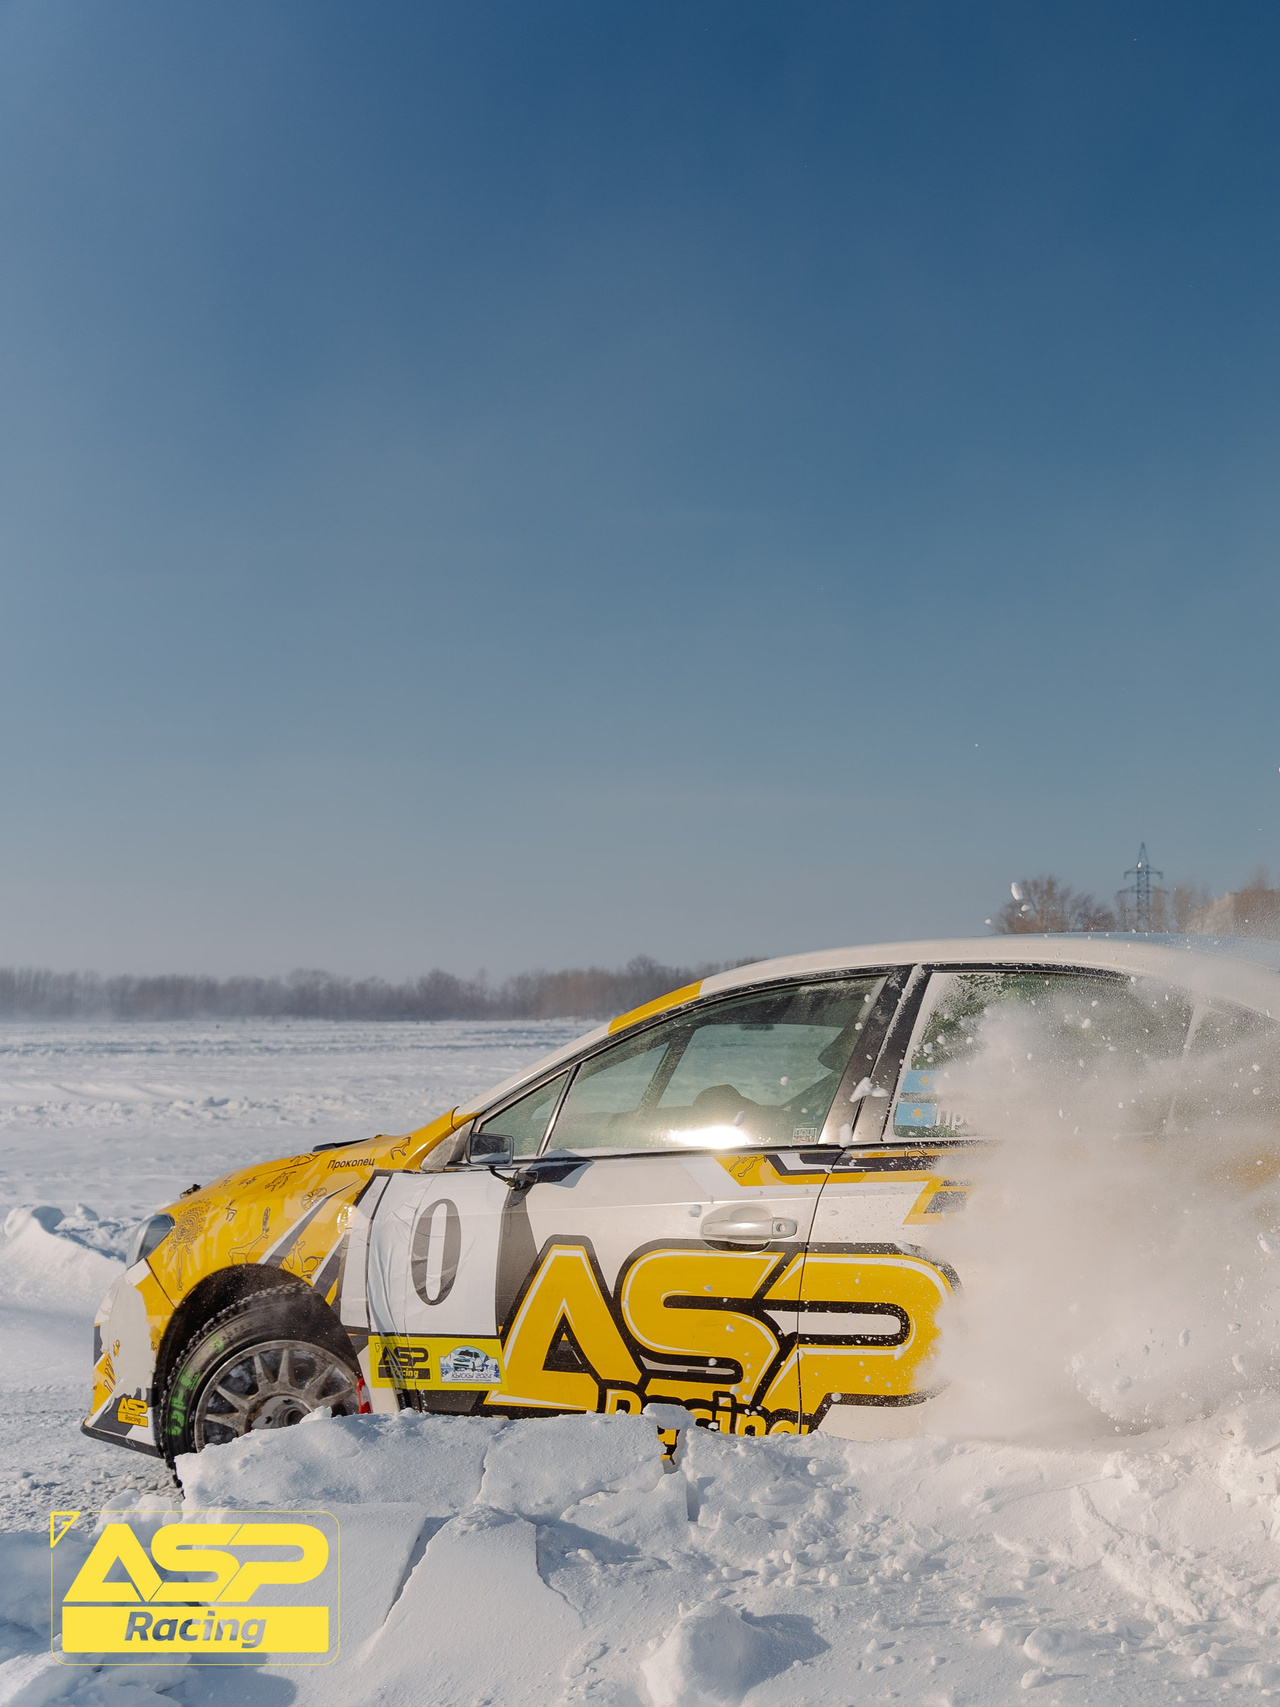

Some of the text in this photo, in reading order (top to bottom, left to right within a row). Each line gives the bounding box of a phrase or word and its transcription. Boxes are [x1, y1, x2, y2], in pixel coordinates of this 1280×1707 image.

[327, 1158, 376, 1171] Прокопец
[411, 1198, 462, 1306] 0
[486, 1239, 956, 1413] ASP
[378, 1346, 429, 1366] ASP
[118, 1397, 148, 1416] ASP
[125, 1414, 142, 1424] Racing
